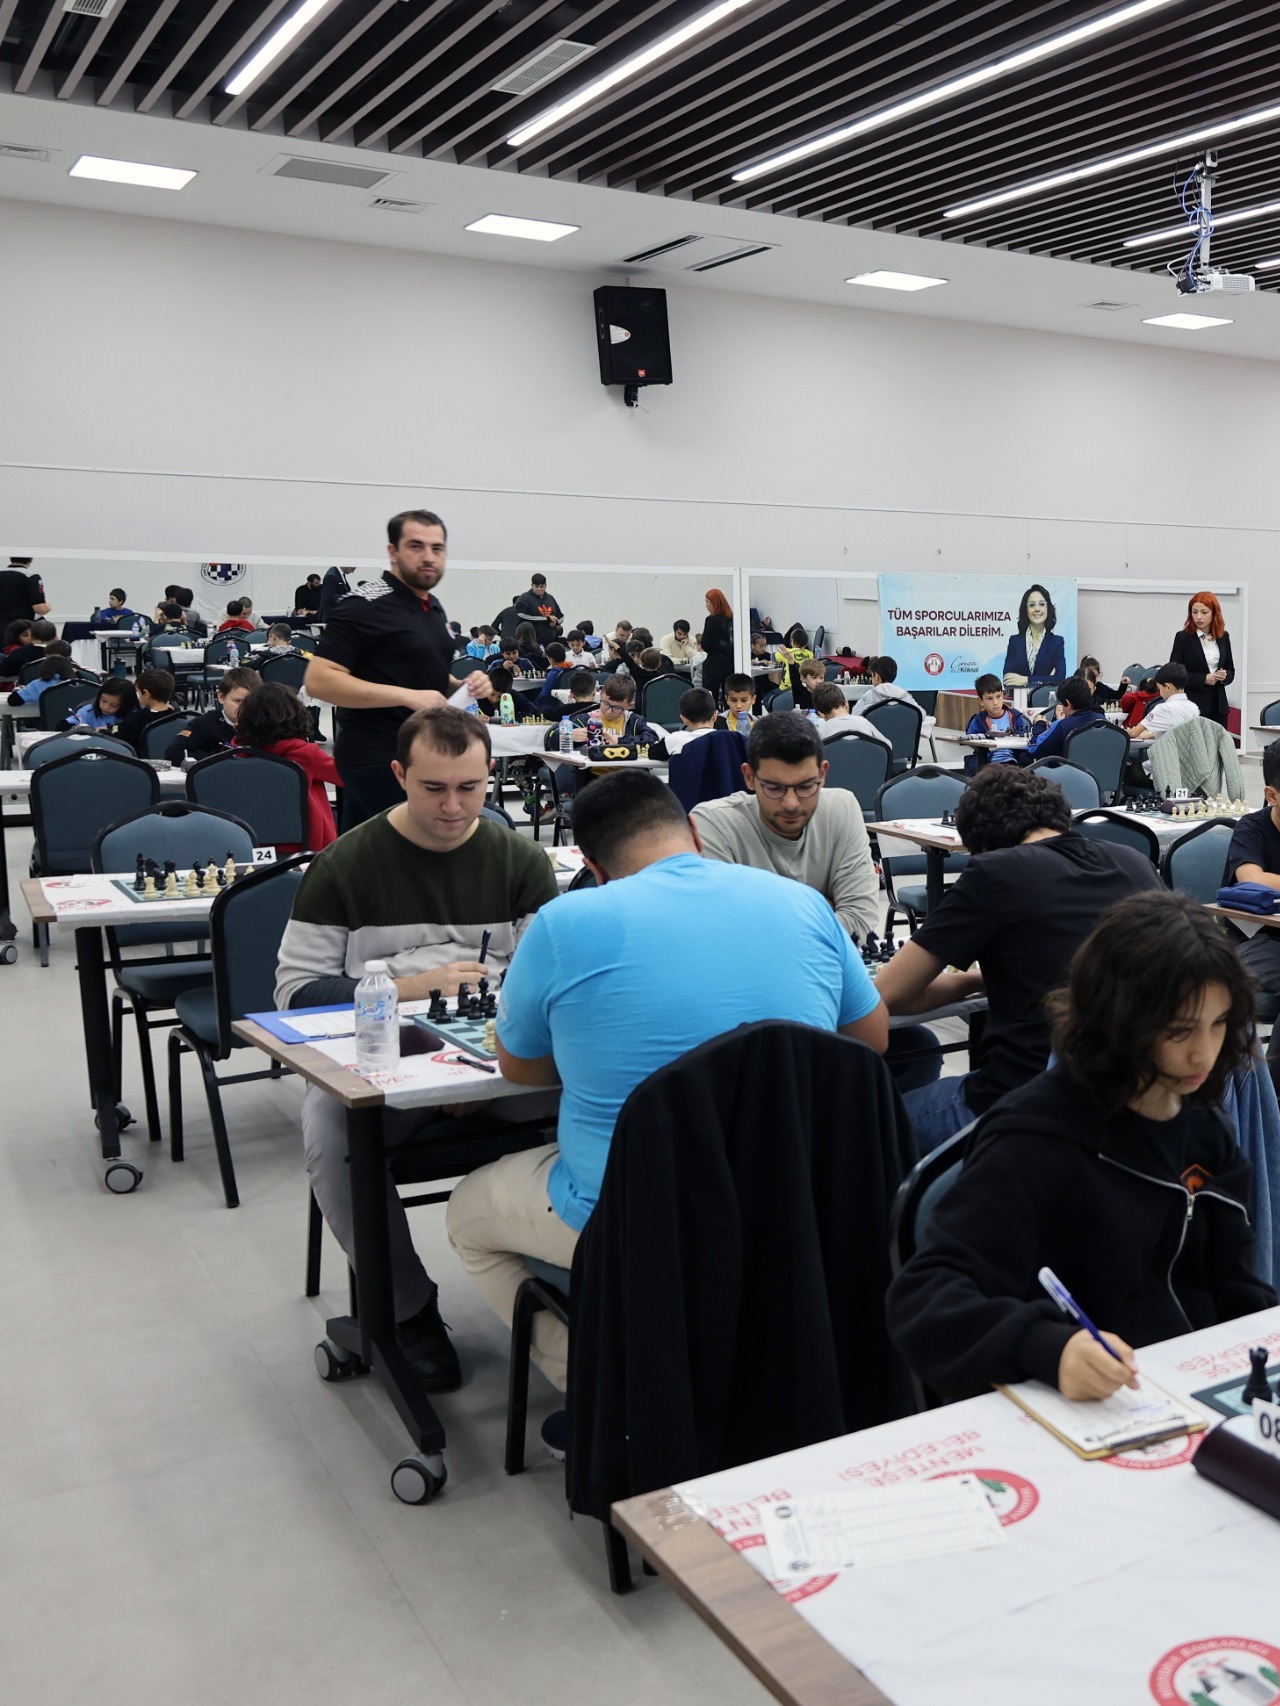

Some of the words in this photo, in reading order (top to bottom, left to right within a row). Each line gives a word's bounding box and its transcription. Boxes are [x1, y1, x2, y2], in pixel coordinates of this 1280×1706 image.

[888, 608, 912, 621] TÜM
[915, 610, 1011, 621] SPORCULARIMIZA
[896, 626, 957, 639] BAŞARILAR
[959, 624, 1004, 637] DİLERİM.
[256, 850, 272, 861] 24
